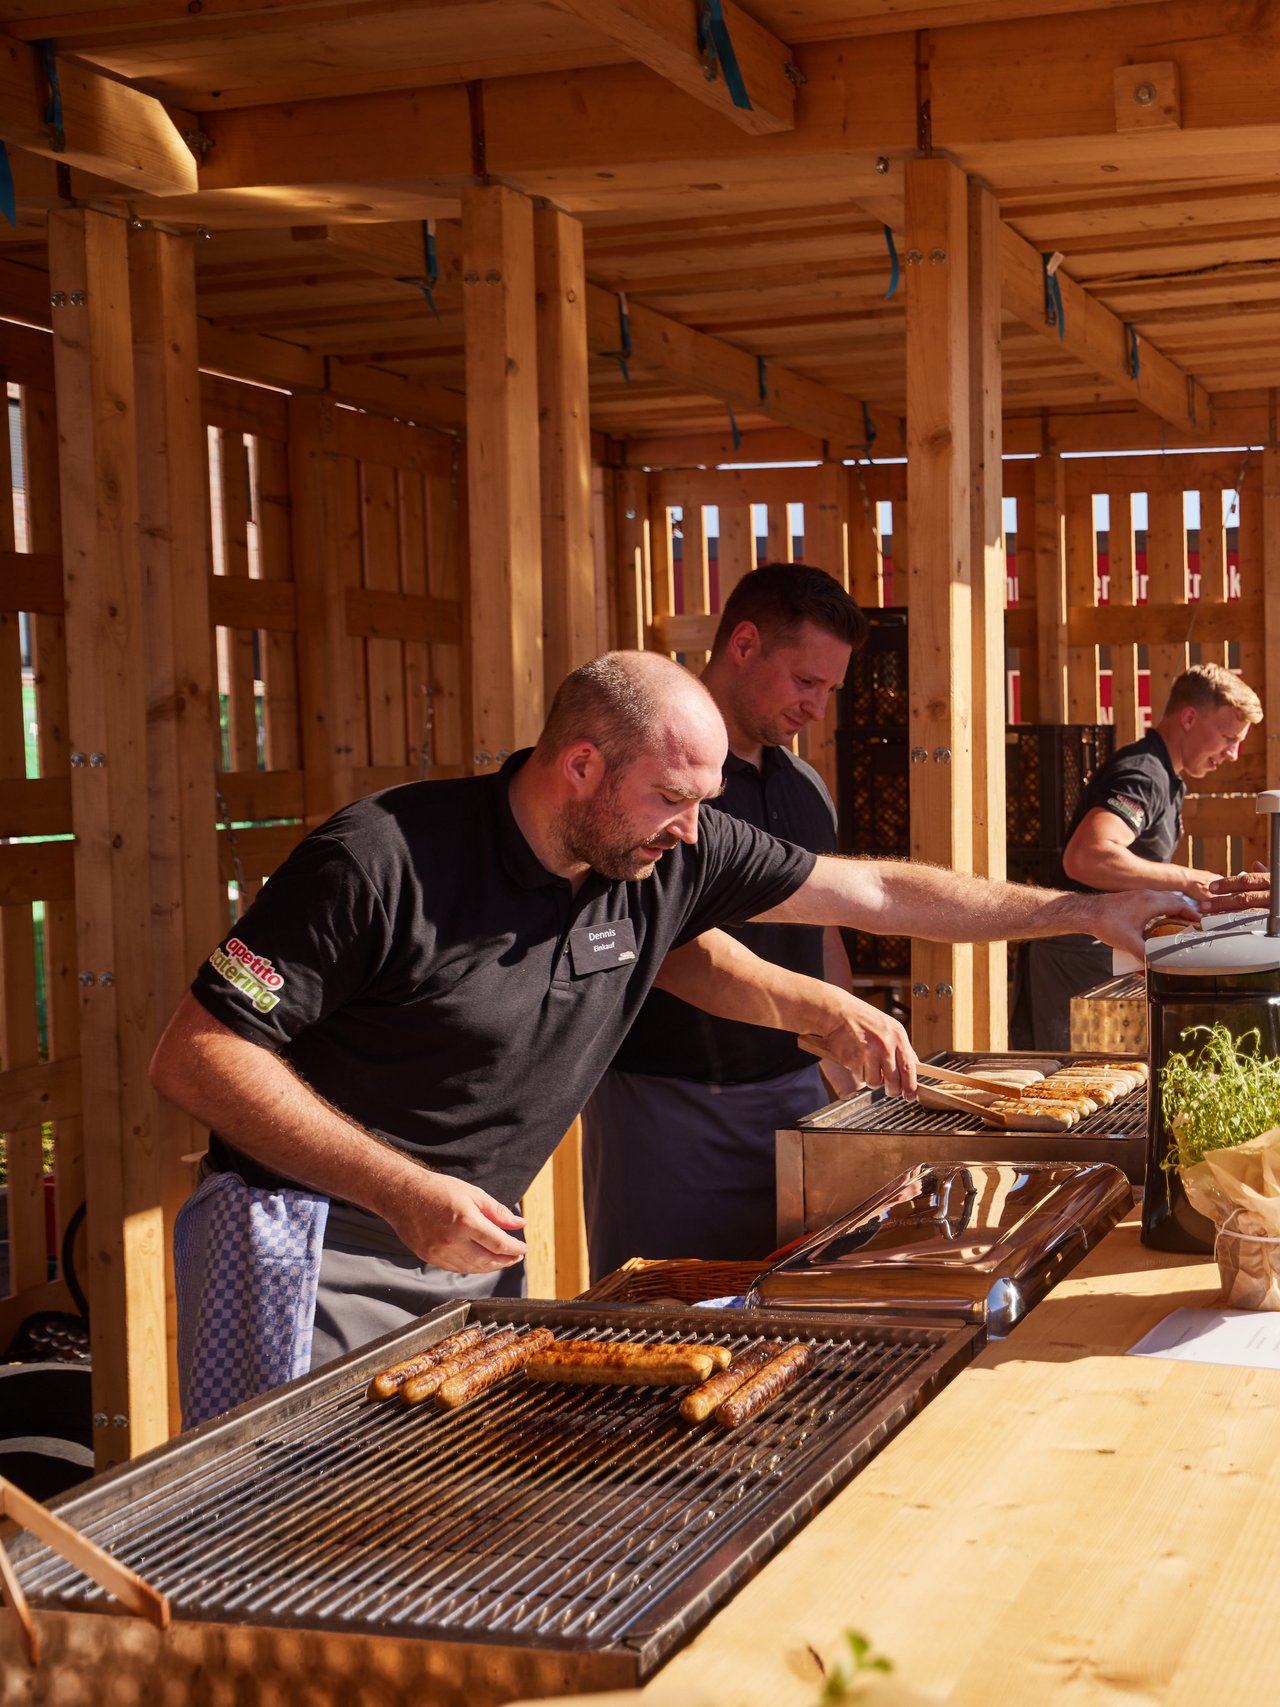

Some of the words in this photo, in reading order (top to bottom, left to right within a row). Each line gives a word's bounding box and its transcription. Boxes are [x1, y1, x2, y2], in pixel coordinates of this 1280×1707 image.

[588, 929, 616, 942] Dennis
[593, 941, 615, 952] Einkauf
[227, 939, 282, 986] apetito
